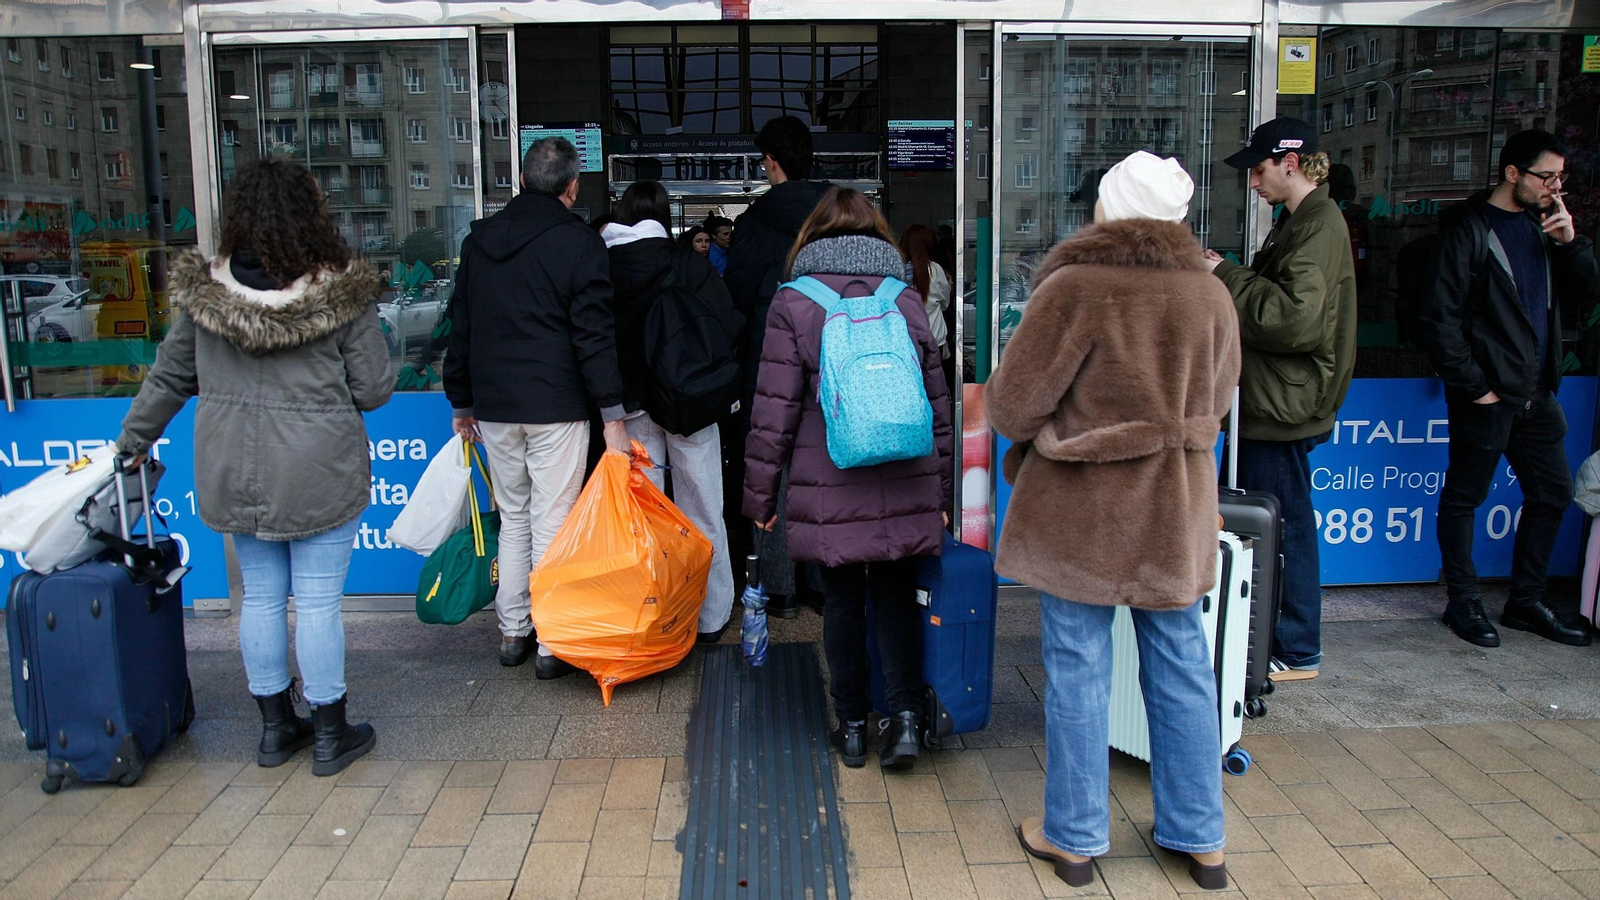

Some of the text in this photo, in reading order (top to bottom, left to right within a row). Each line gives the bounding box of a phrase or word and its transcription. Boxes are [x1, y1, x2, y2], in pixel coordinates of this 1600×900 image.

[642, 140, 662, 148] Acceso
[663, 140, 690, 148] andenes
[698, 139, 718, 147] Acceso
[95, 259, 121, 268] TRAVEL
[1311, 465, 1375, 491] Calle
[1385, 506, 1424, 543] 51
